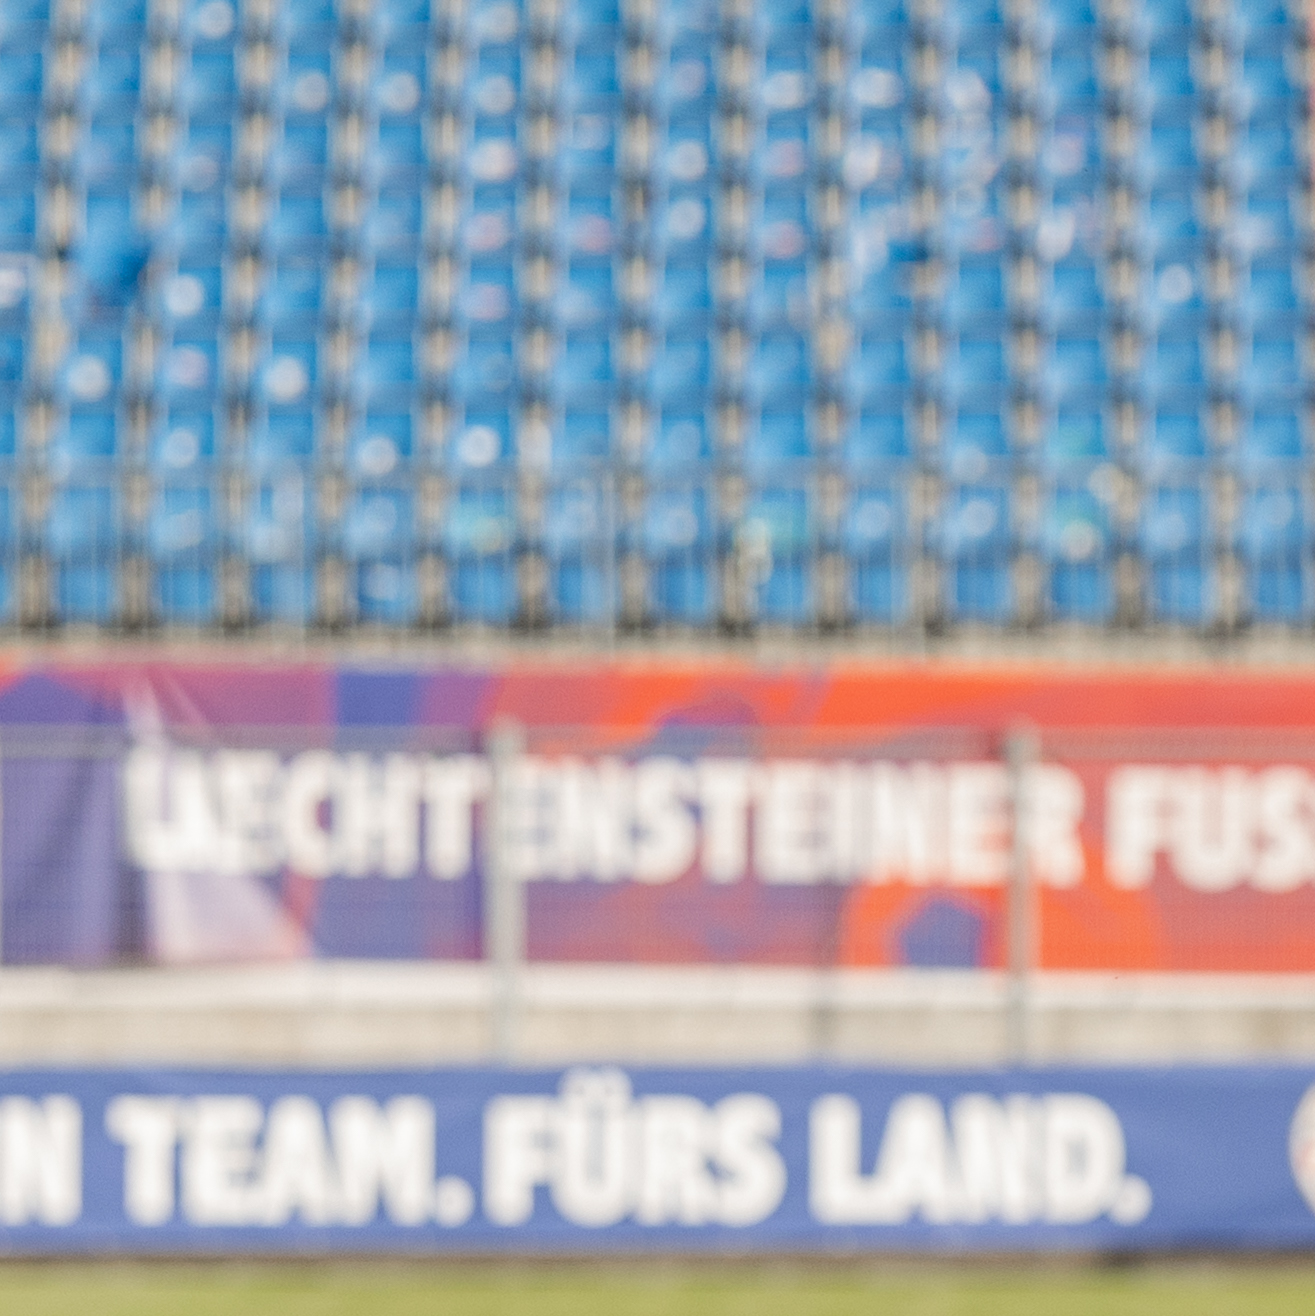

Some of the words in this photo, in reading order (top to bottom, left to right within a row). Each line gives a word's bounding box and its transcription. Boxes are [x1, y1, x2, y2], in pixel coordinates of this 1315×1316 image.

[104, 1092, 474, 1228] TEAM.
[482, 1066, 788, 1228] FÜRS
[808, 1091, 1154, 1228] LAND.
